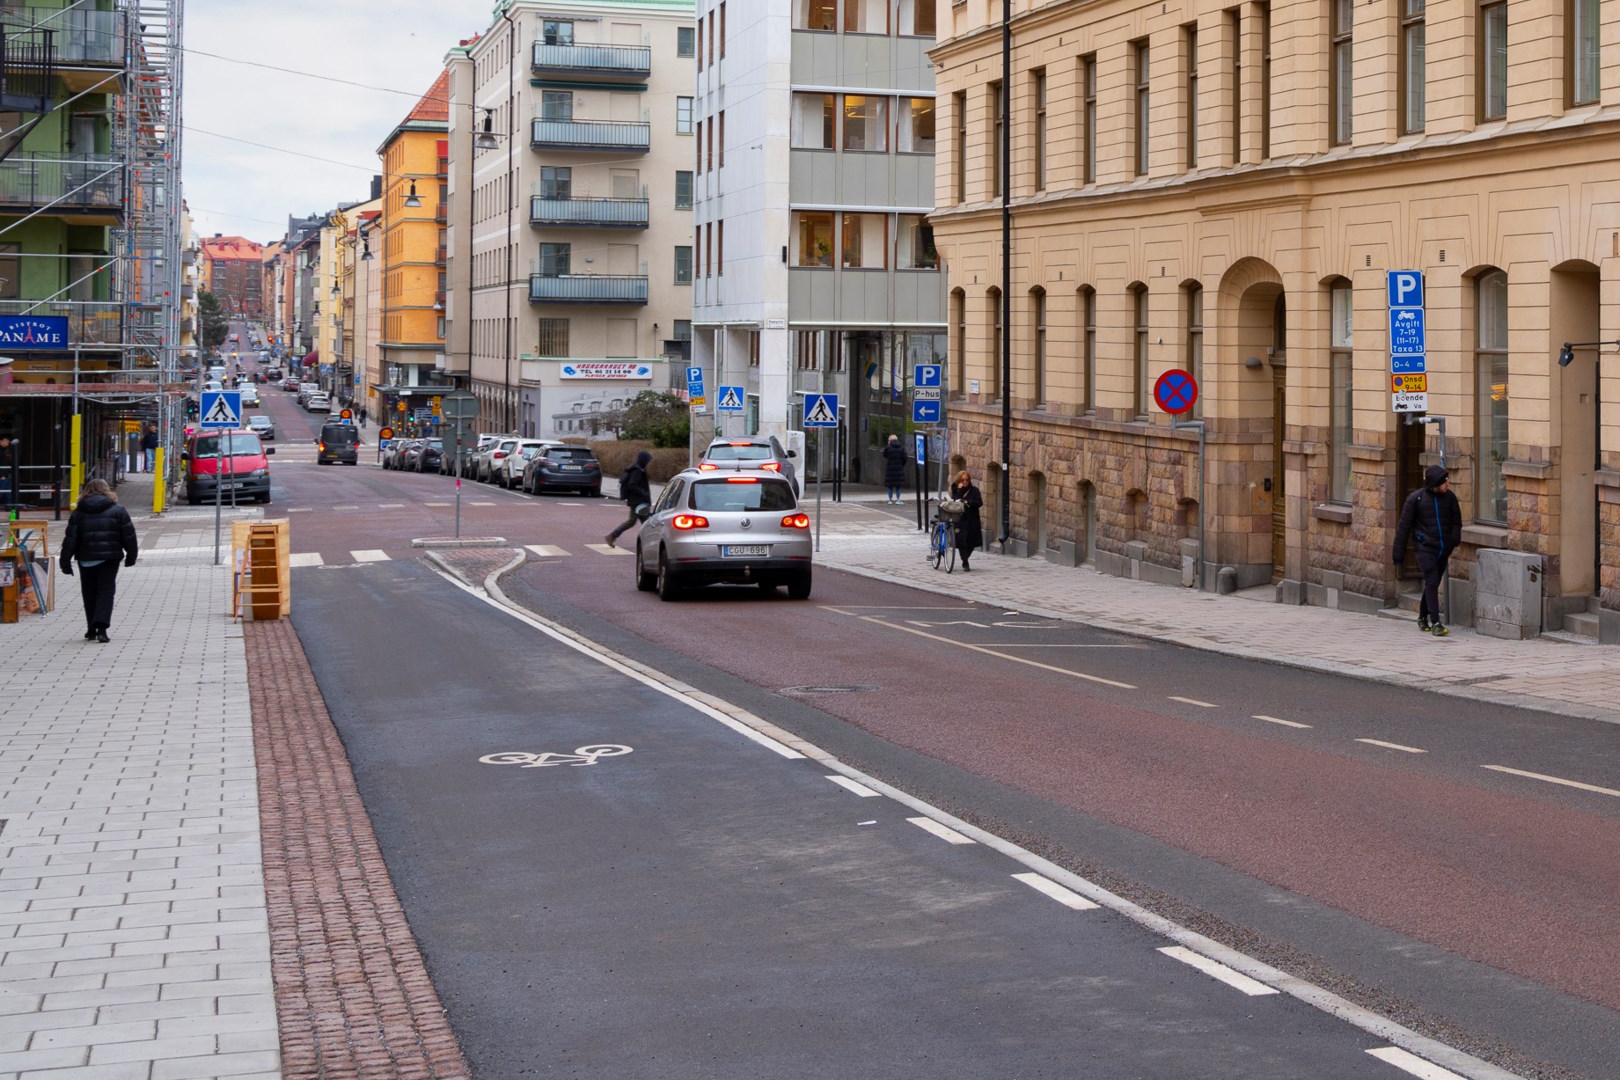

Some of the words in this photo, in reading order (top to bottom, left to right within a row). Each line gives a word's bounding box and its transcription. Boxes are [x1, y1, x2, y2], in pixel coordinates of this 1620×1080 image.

[1397, 275, 1416, 304] P
[1395, 321, 1420, 329] Avgift
[1396, 337, 1419, 345] (11-17)
[691, 369, 700, 380] P
[922, 367, 935, 384] P
